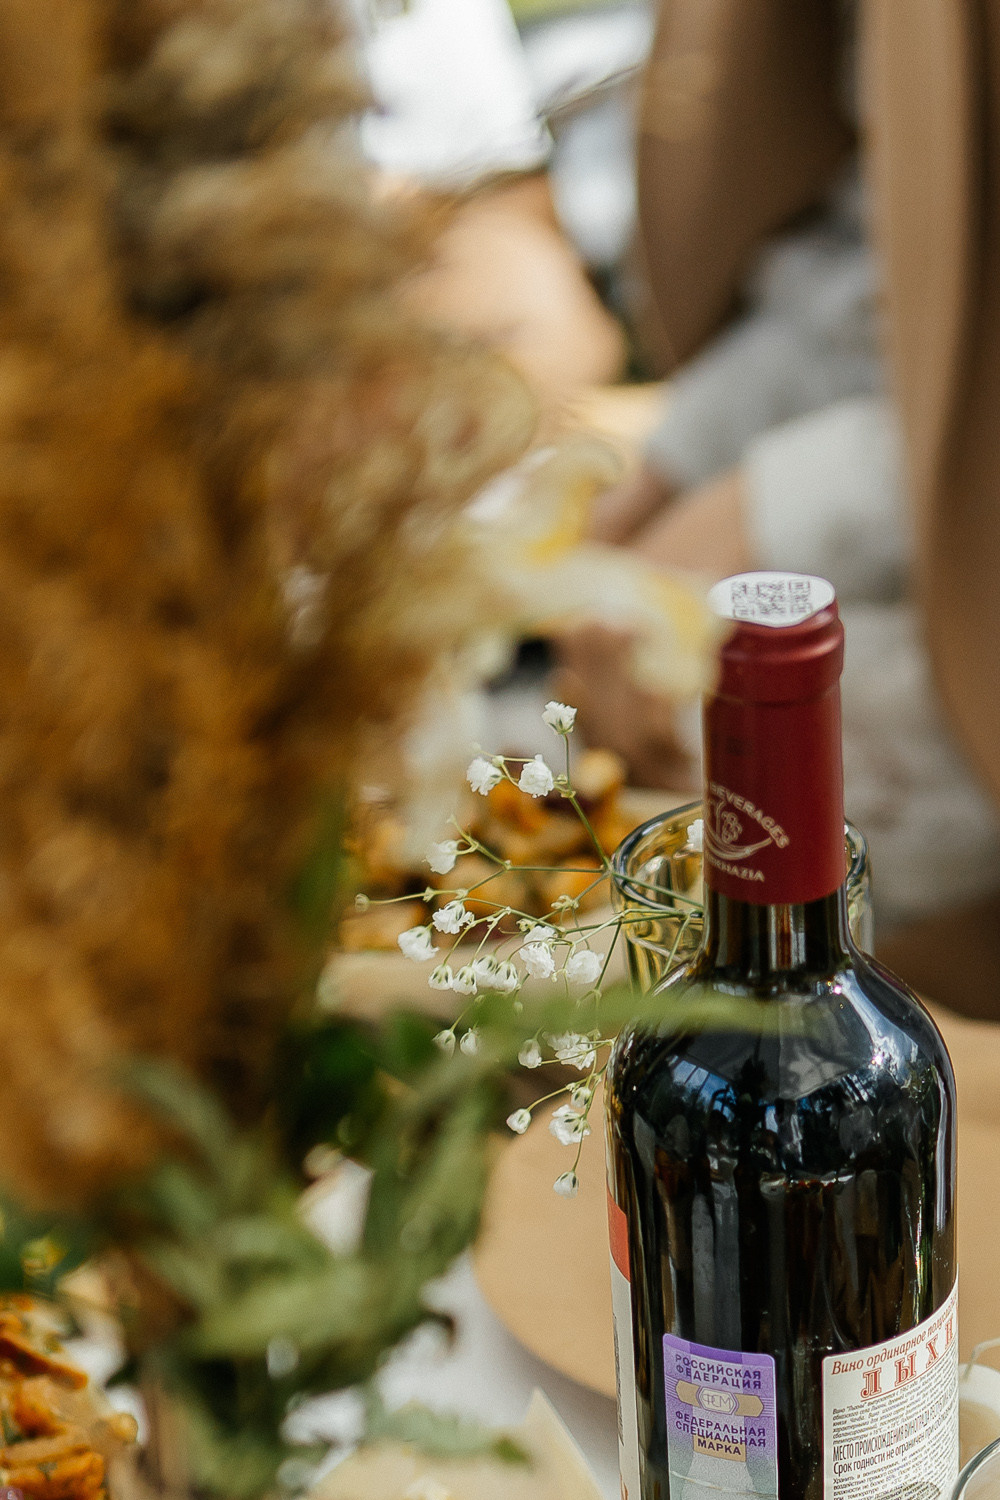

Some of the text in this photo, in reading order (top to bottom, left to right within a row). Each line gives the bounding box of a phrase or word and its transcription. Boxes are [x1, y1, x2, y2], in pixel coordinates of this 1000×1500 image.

[832, 1360, 864, 1375] Вино
[866, 1330, 926, 1368] ординарное
[675, 1353, 761, 1380] РОССИЙСКАЯ
[675, 1364, 761, 1389] ФЕДЕРАЦИЯ
[675, 1410, 766, 1437] ФЕДЕРАЛЬНАЯ
[675, 1420, 766, 1448] СПЕЦИАЛЬНАЯ
[697, 1438, 741, 1455] МАРКА
[833, 1442, 853, 1462] МЕСТО
[834, 1459, 852, 1476] Срок
[854, 1449, 886, 1473] годности
